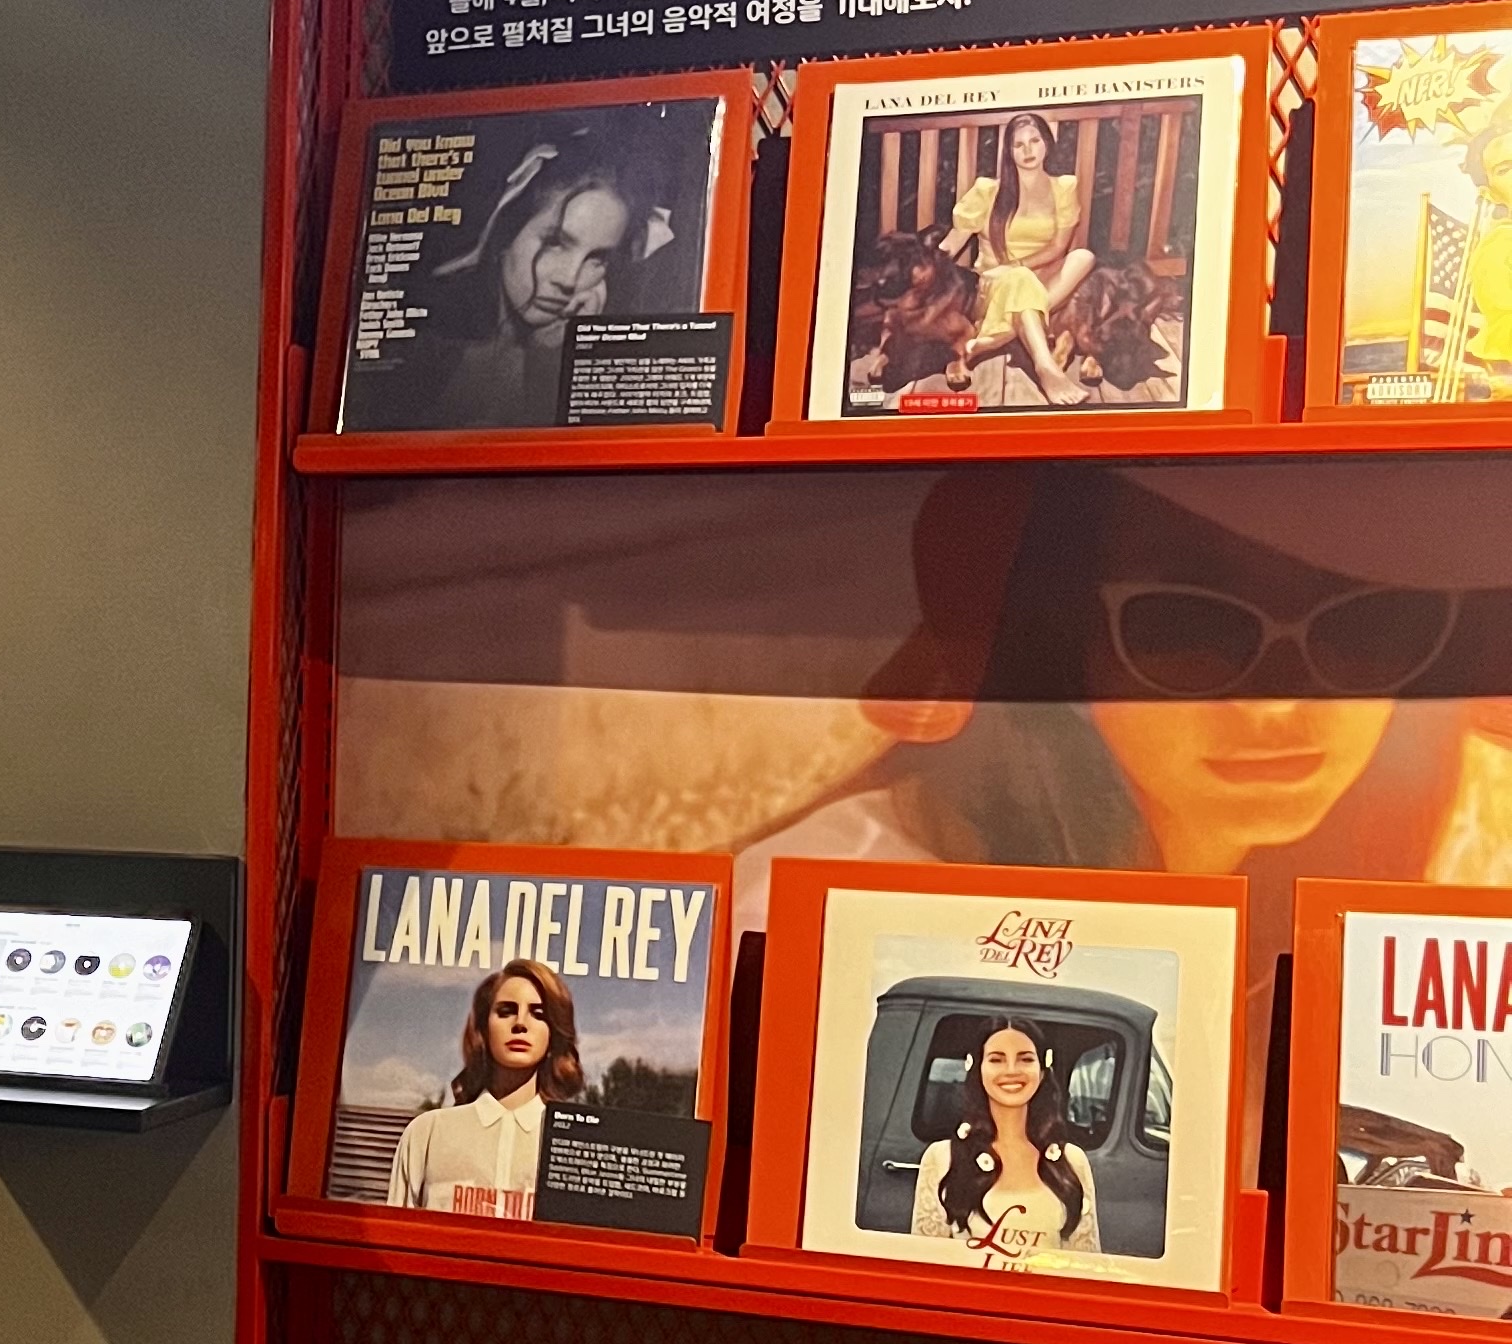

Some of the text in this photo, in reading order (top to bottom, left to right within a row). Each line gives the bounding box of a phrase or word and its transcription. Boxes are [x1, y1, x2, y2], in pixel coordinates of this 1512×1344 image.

[425, 24, 495, 55] 앞으로
[502, 16, 573, 48] 펼쳐질
[580, 8, 654, 39] 그녀의
[661, 0, 737, 34] 음악적
[865, 90, 1001, 110] LANA DEL REY
[1037, 76, 1206, 99] BLUE BANISTERS
[362, 873, 490, 969] LANA
[598, 885, 707, 984] REY
[975, 910, 1075, 951] LANA
[1007, 938, 1074, 979] REY
[966, 1205, 1047, 1258] LUST
